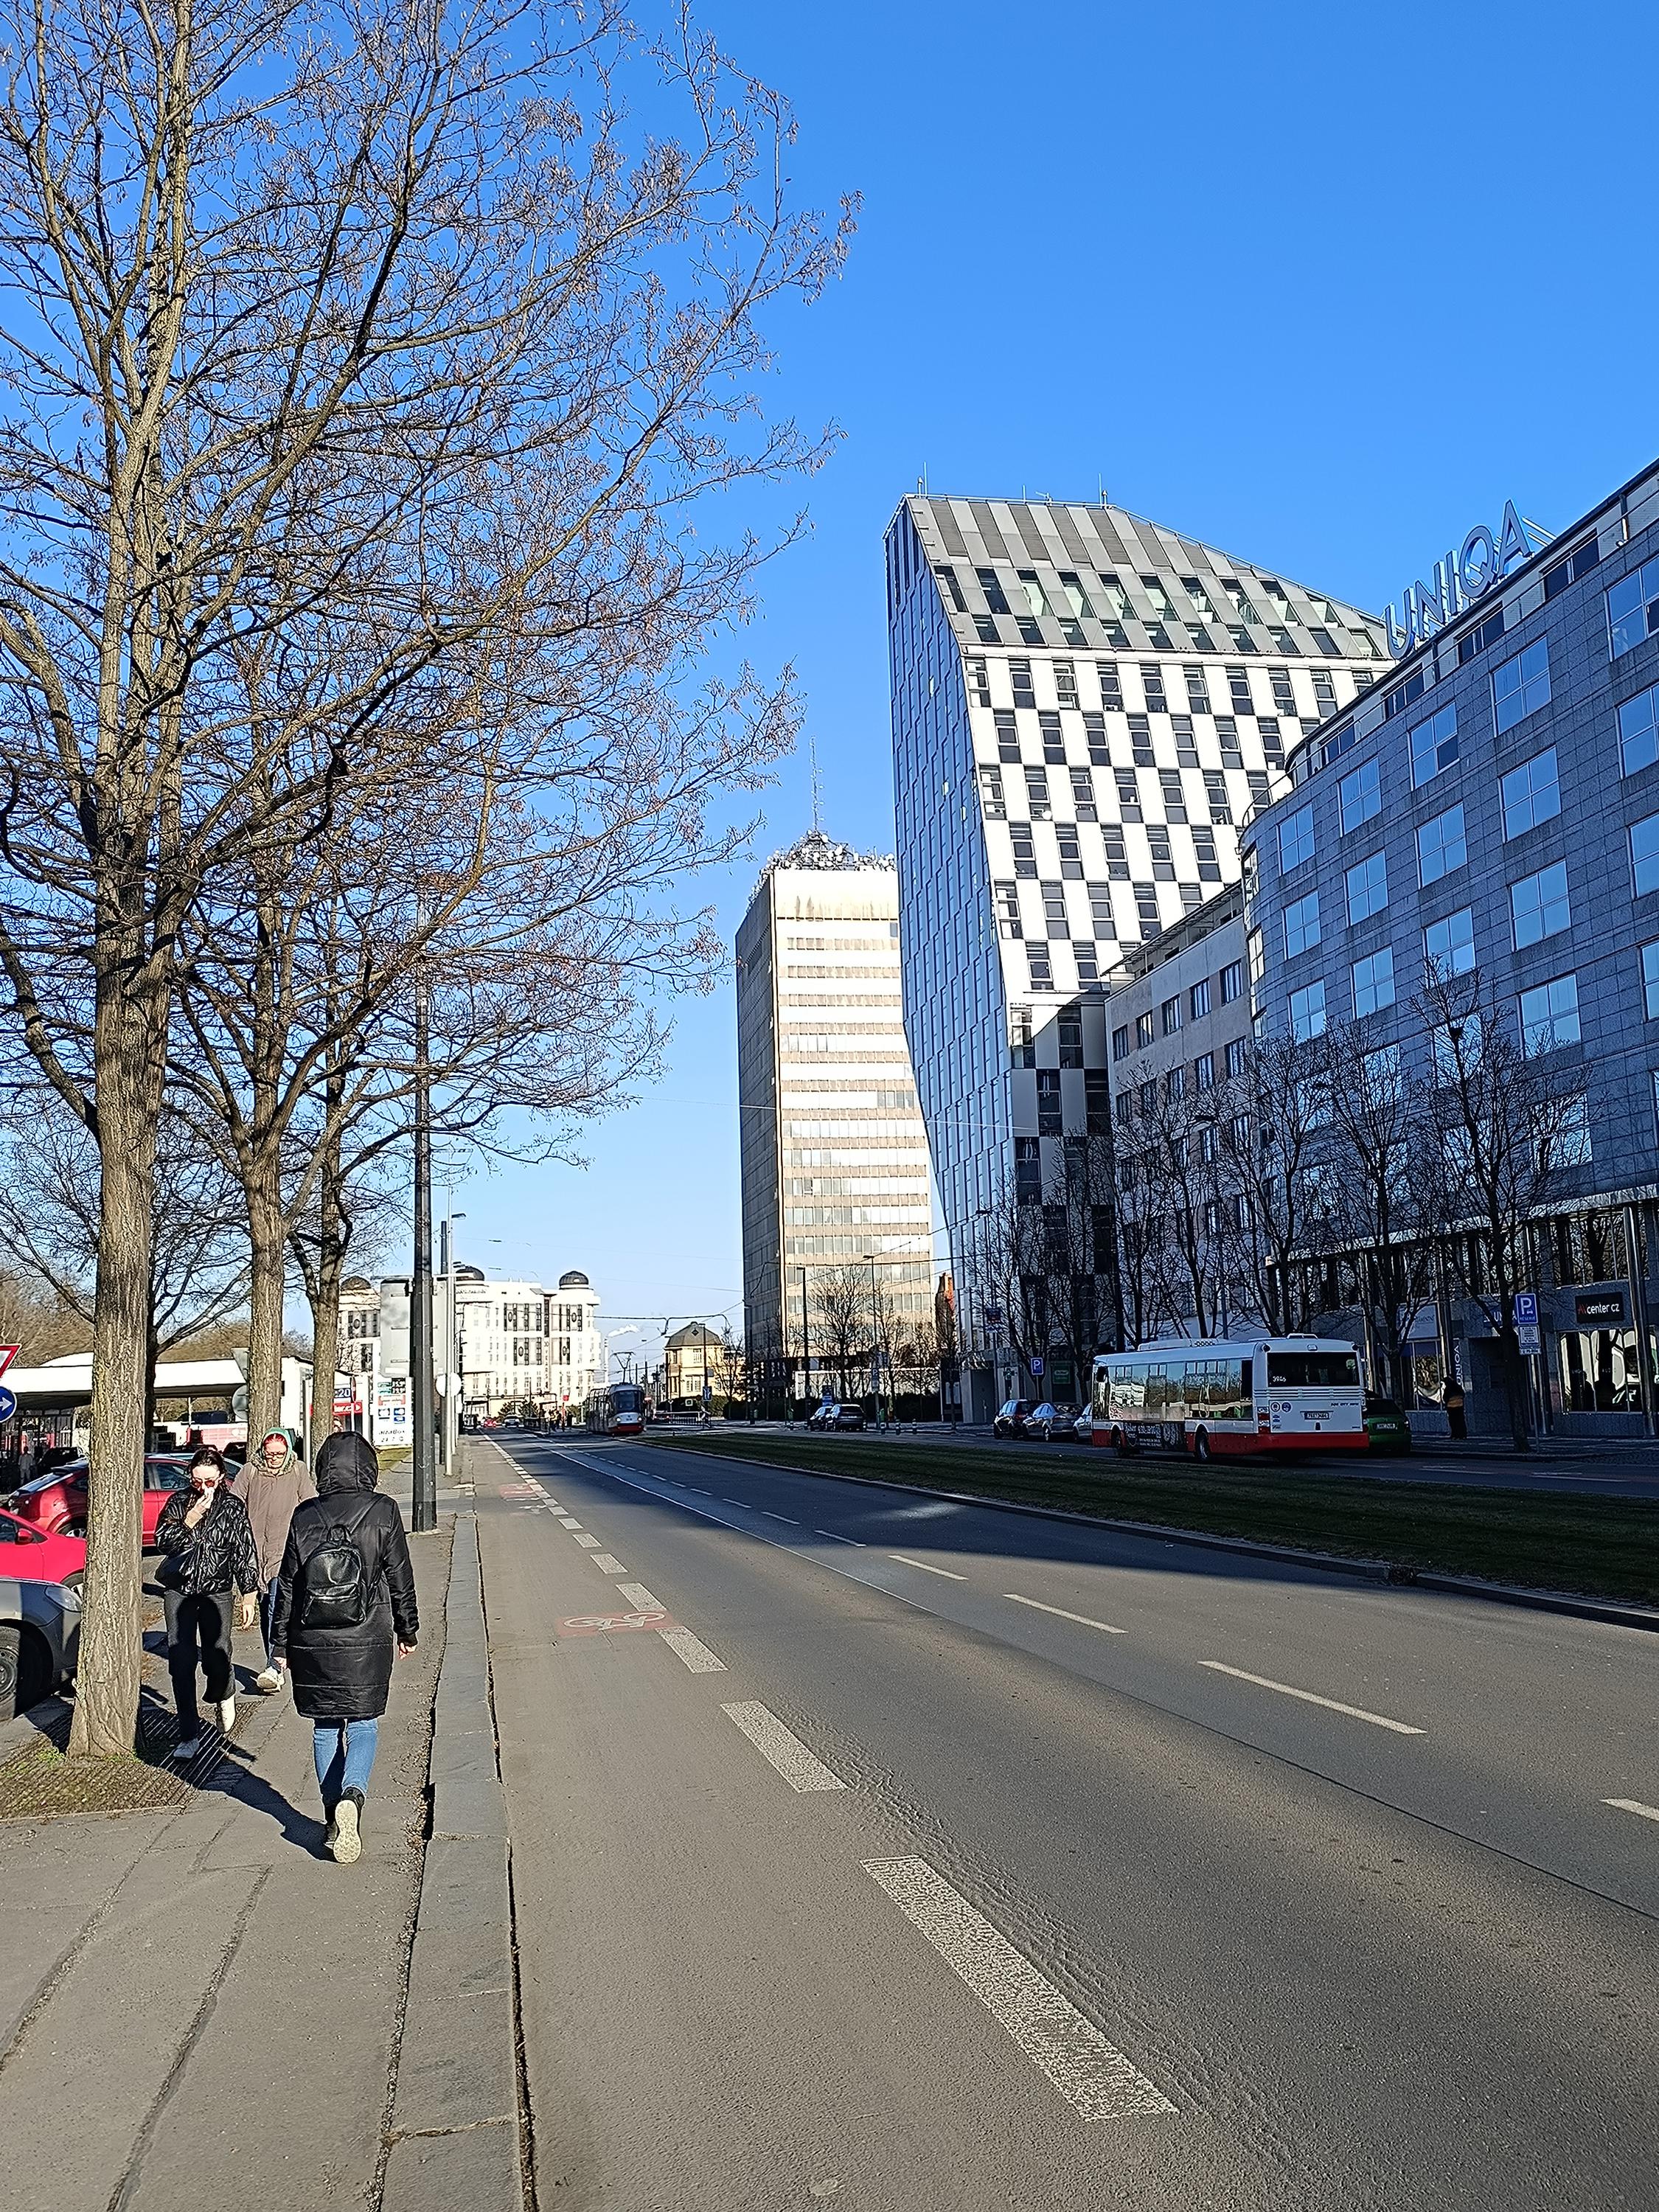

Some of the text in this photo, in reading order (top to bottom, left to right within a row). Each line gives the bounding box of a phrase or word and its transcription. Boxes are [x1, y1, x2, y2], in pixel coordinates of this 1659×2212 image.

[1384, 498, 1533, 660] UNIQA
[1520, 1297, 1532, 1315] P
[1034, 1360, 1040, 1370] P
